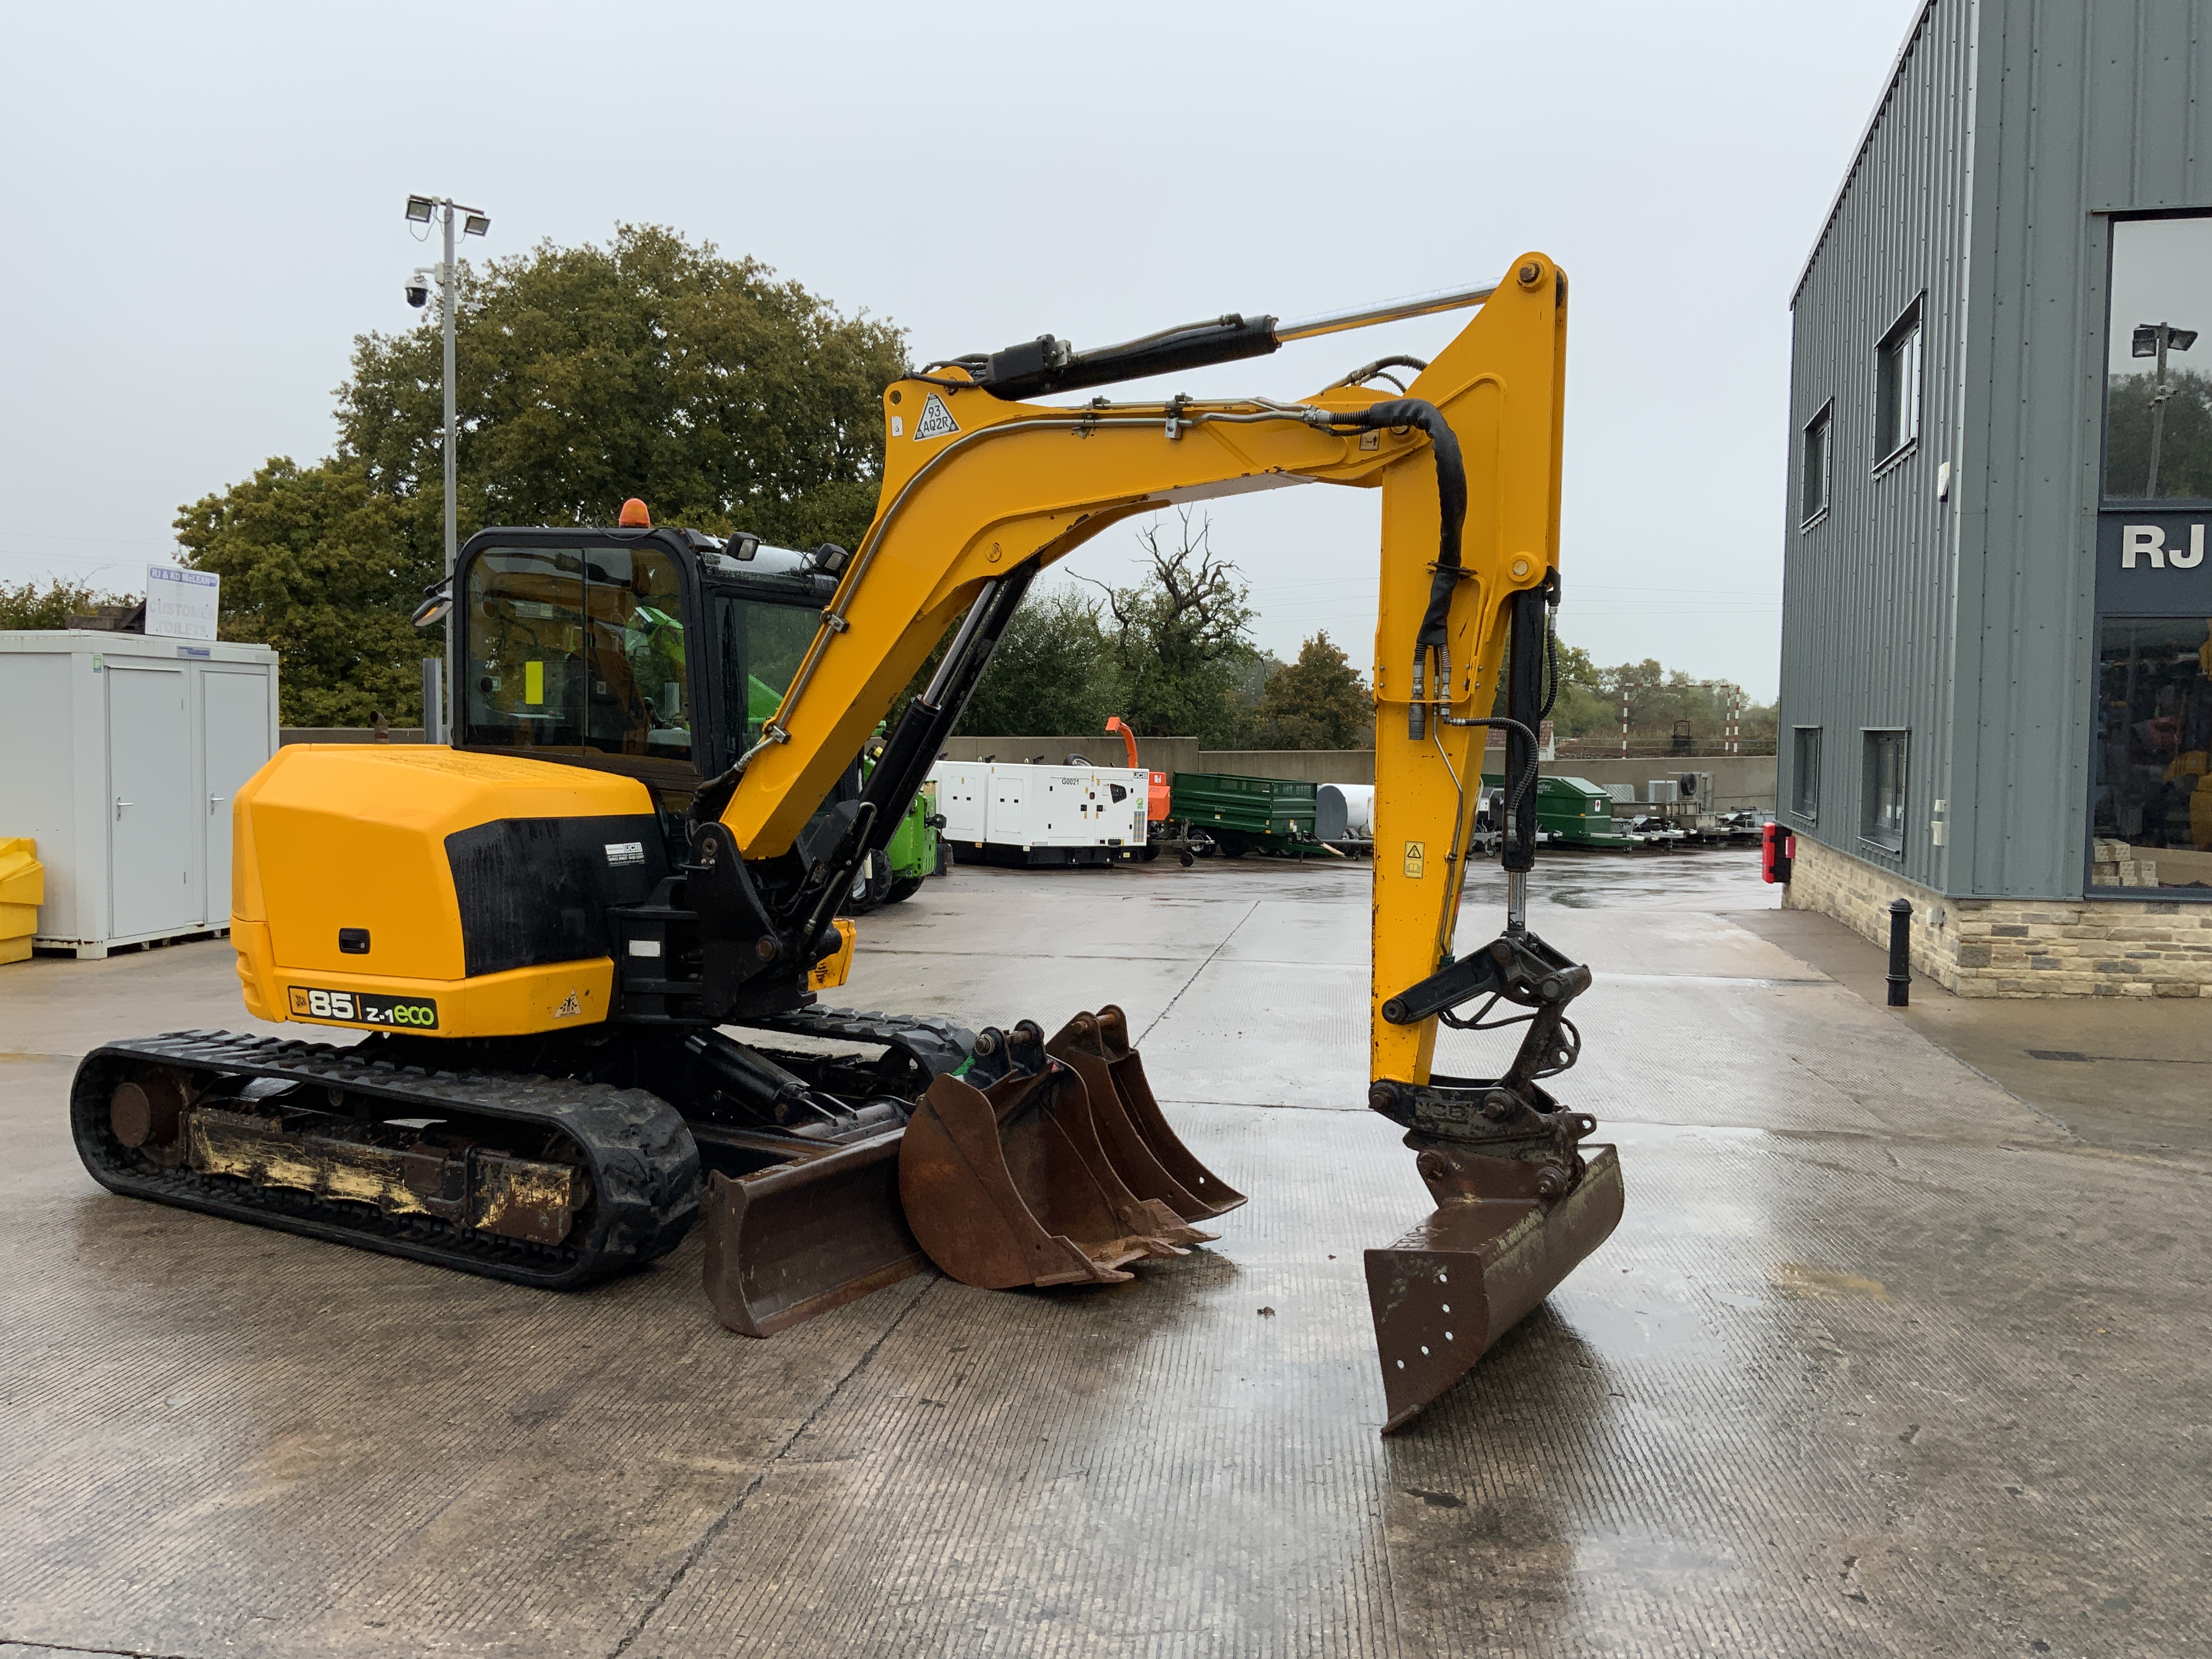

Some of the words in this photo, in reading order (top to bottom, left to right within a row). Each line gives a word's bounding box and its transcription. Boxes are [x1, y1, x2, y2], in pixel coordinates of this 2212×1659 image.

[928, 405, 941, 419] 93
[924, 416, 949, 432] AQ2R
[2121, 524, 2205, 568] RJ
[151, 568, 161, 578] RJ
[162, 570, 168, 579] &
[170, 571, 180, 580] KD
[157, 619, 207, 636] TOILETS
[309, 990, 354, 1019] 85
